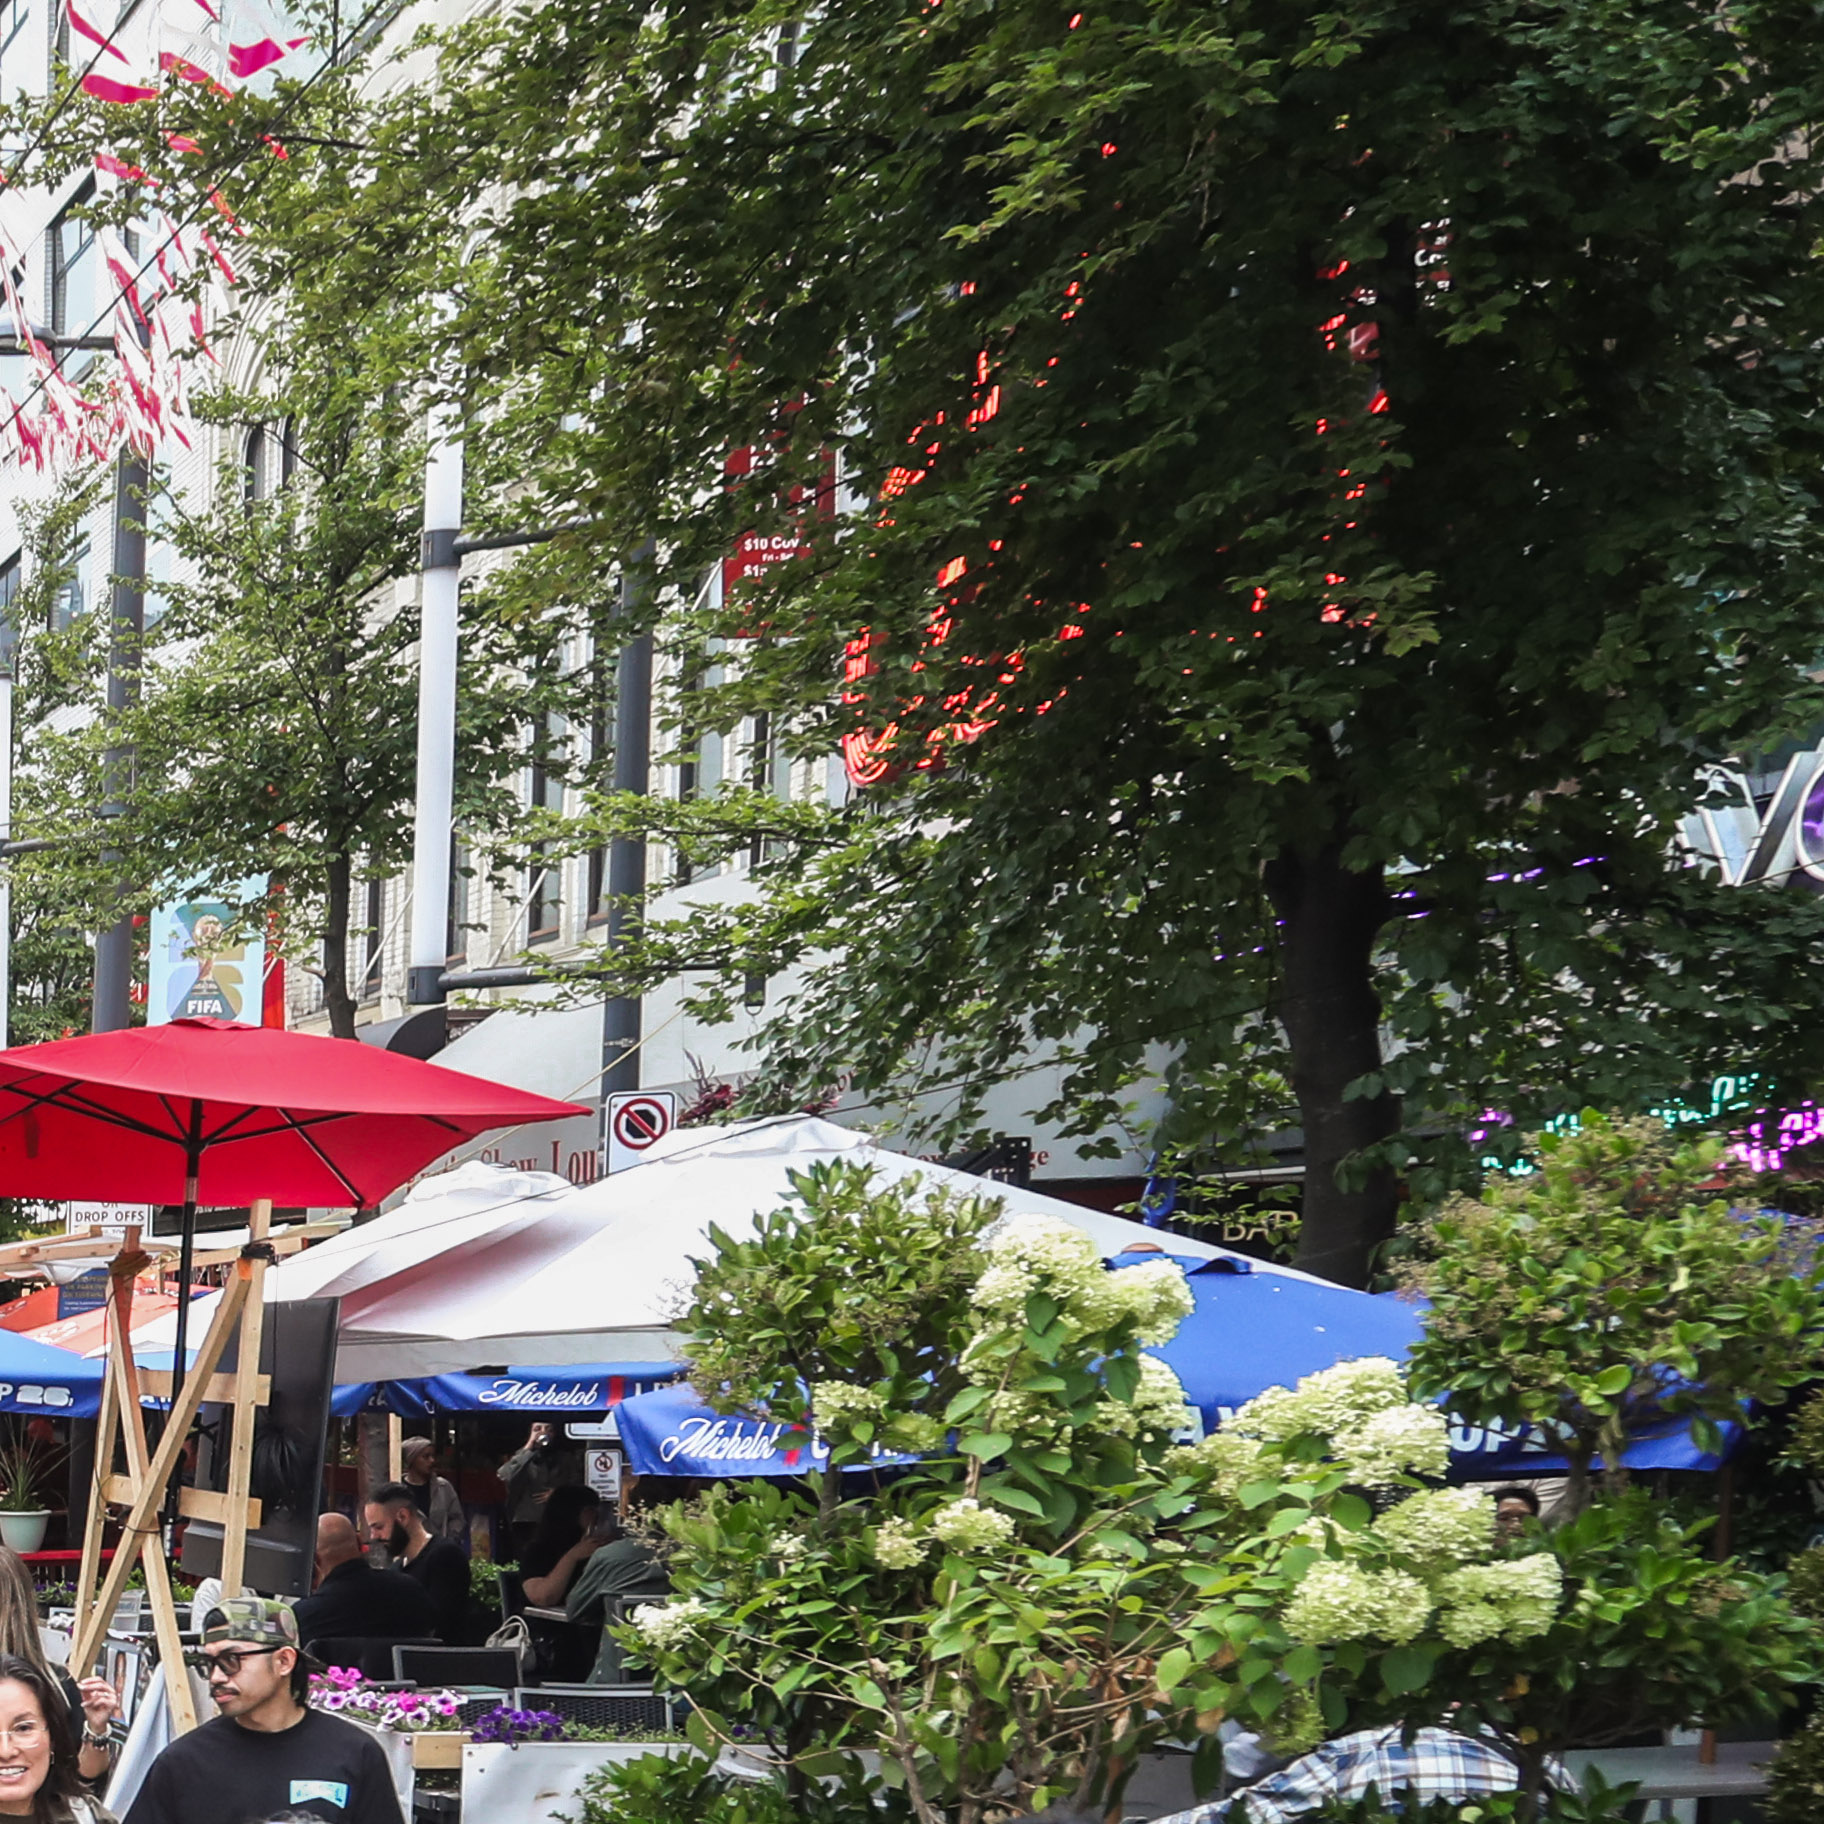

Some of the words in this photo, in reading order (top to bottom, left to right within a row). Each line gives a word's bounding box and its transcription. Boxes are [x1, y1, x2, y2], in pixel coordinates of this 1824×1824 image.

[744, 537, 768, 551] $10
[186, 999, 223, 1015] FIFA
[75, 1211, 109, 1222] DROP
[114, 1210, 145, 1222] OFFS
[477, 1379, 599, 1407] Michelob
